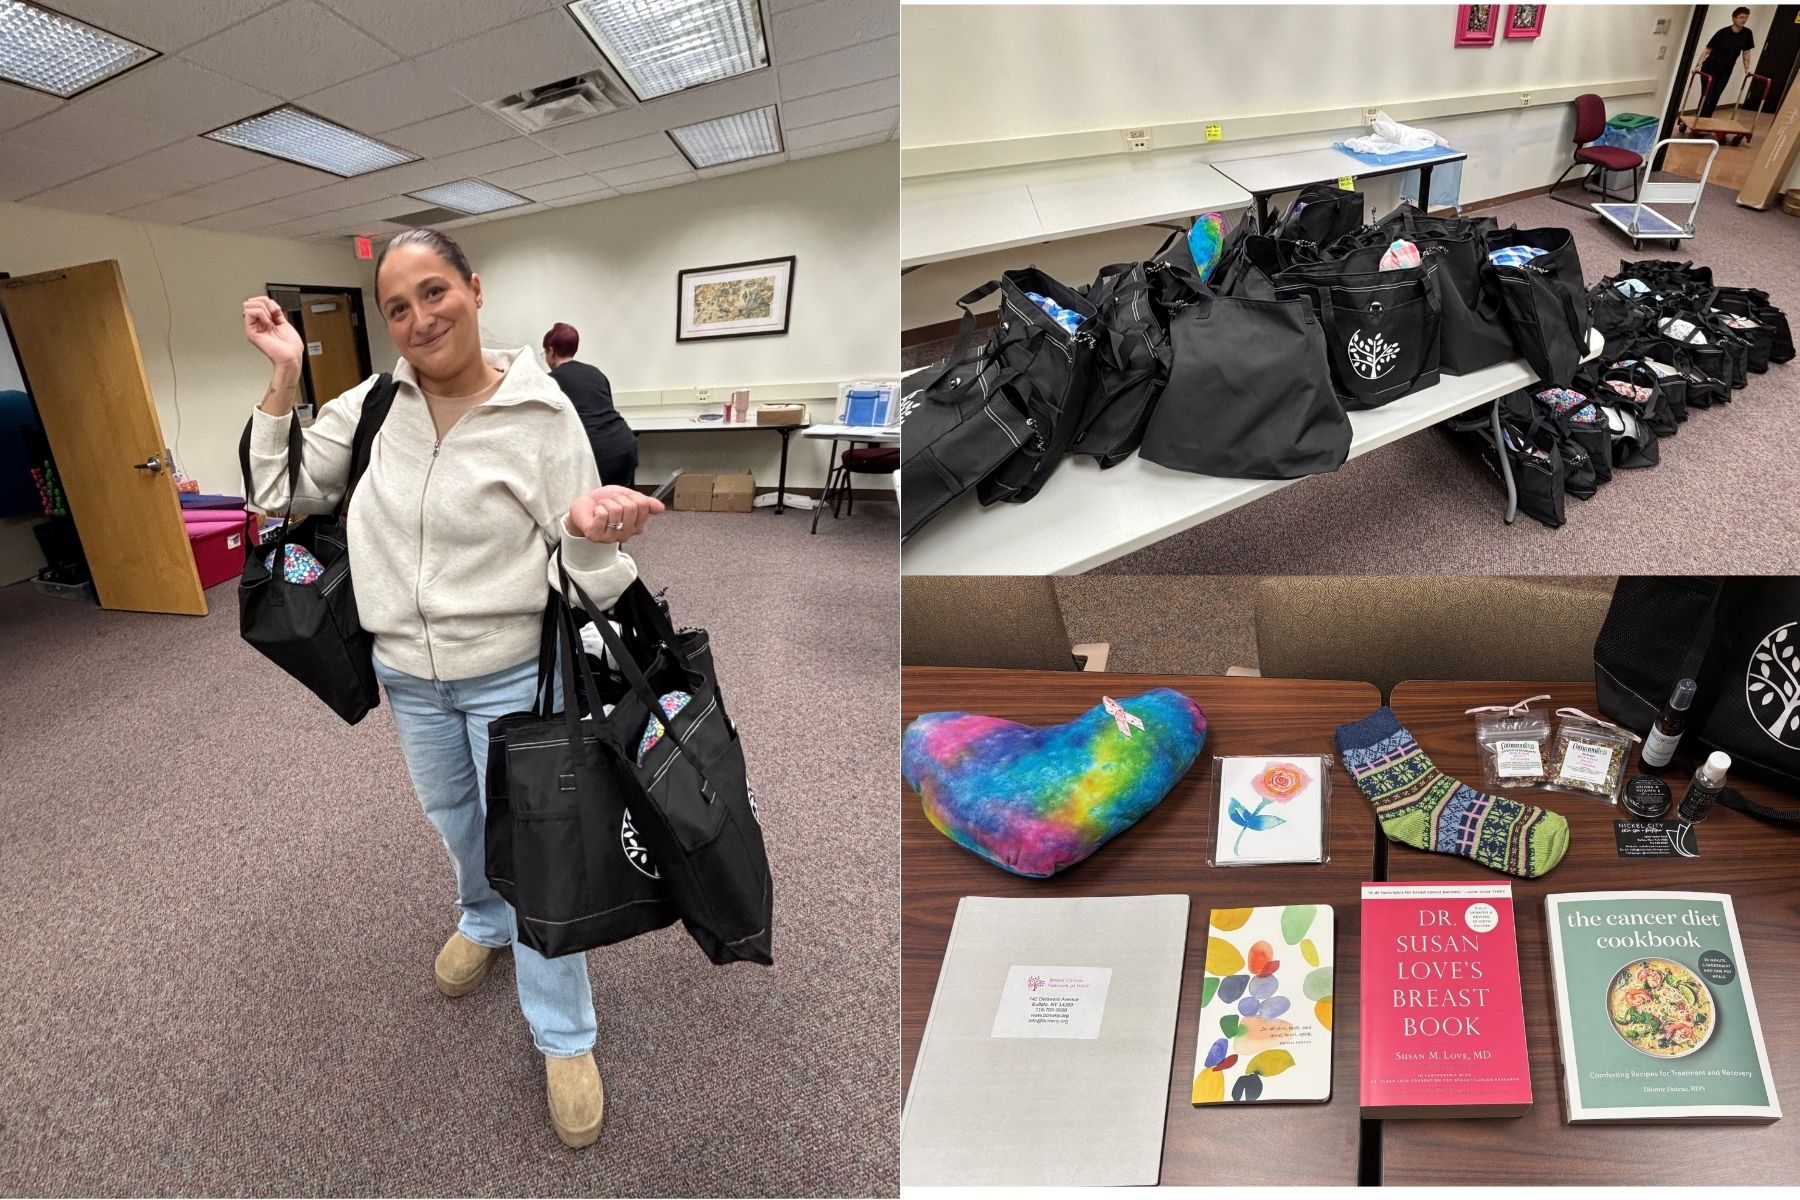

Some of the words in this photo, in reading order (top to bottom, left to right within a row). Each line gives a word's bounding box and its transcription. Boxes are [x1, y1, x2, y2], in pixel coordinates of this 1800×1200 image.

[1419, 909, 1457, 927] DR.
[1567, 911, 1601, 928] the
[1606, 912, 1677, 926] cancer
[1681, 910, 1721, 927] diet
[1396, 935, 1480, 953] SUSAN
[1596, 930, 1702, 949] cookbook
[1398, 961, 1483, 980] LOVE'S
[1392, 988, 1490, 1008] BREAST
[1404, 1017, 1482, 1036] BOOK
[1395, 1051, 1425, 1060] SUSAN
[1429, 1051, 1441, 1060] M.
[1444, 1051, 1471, 1061] LOVE,
[1473, 1050, 1492, 1060] MD
[1589, 1071, 1630, 1080] Comforting
[1631, 1070, 1659, 1079] Recipes
[1671, 1069, 1706, 1077] Treatment
[1722, 1069, 1752, 1078] Recovery
